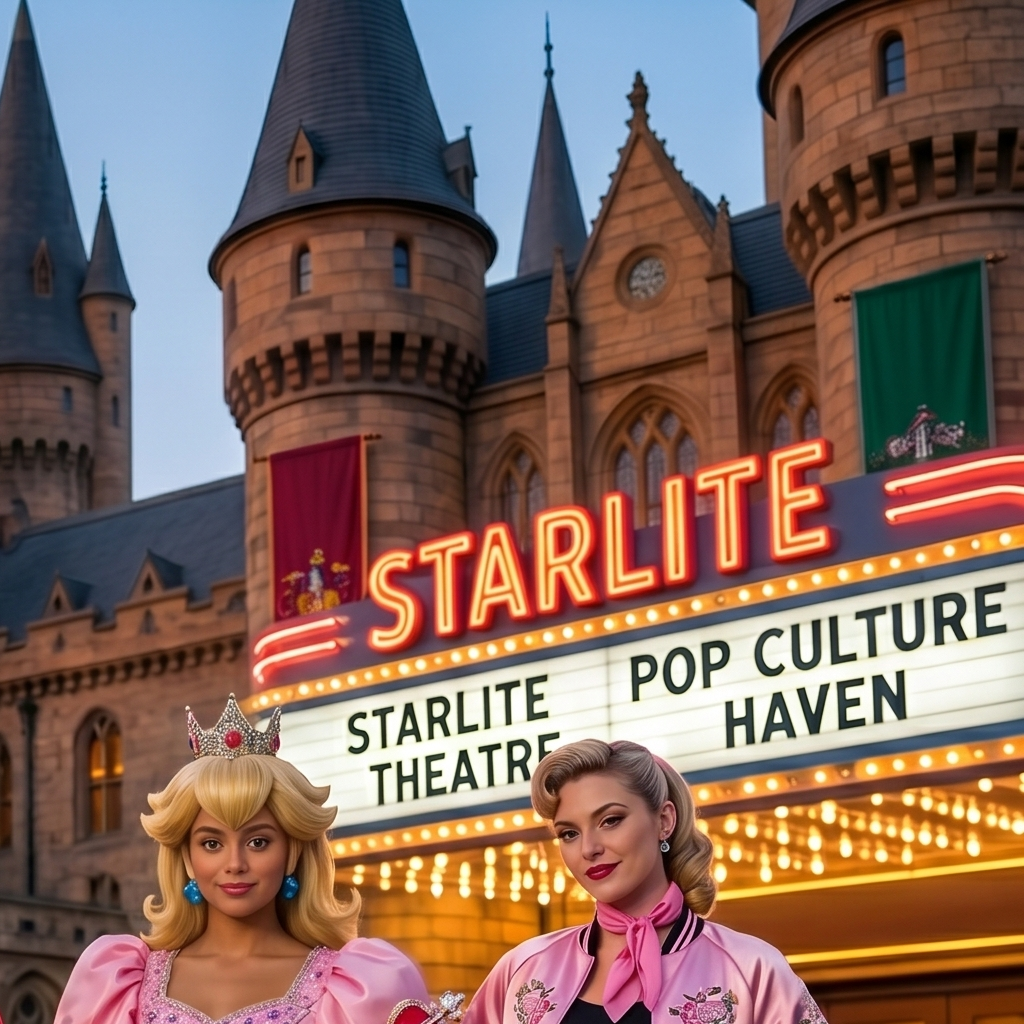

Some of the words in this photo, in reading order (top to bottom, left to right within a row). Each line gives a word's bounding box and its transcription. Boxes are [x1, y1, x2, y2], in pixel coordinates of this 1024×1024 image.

[368, 438, 833, 652] STARLITE
[630, 640, 731, 702] POP
[754, 582, 1007, 677] CULTURE
[347, 674, 549, 755] STARLITE
[724, 670, 907, 749] HAVEN
